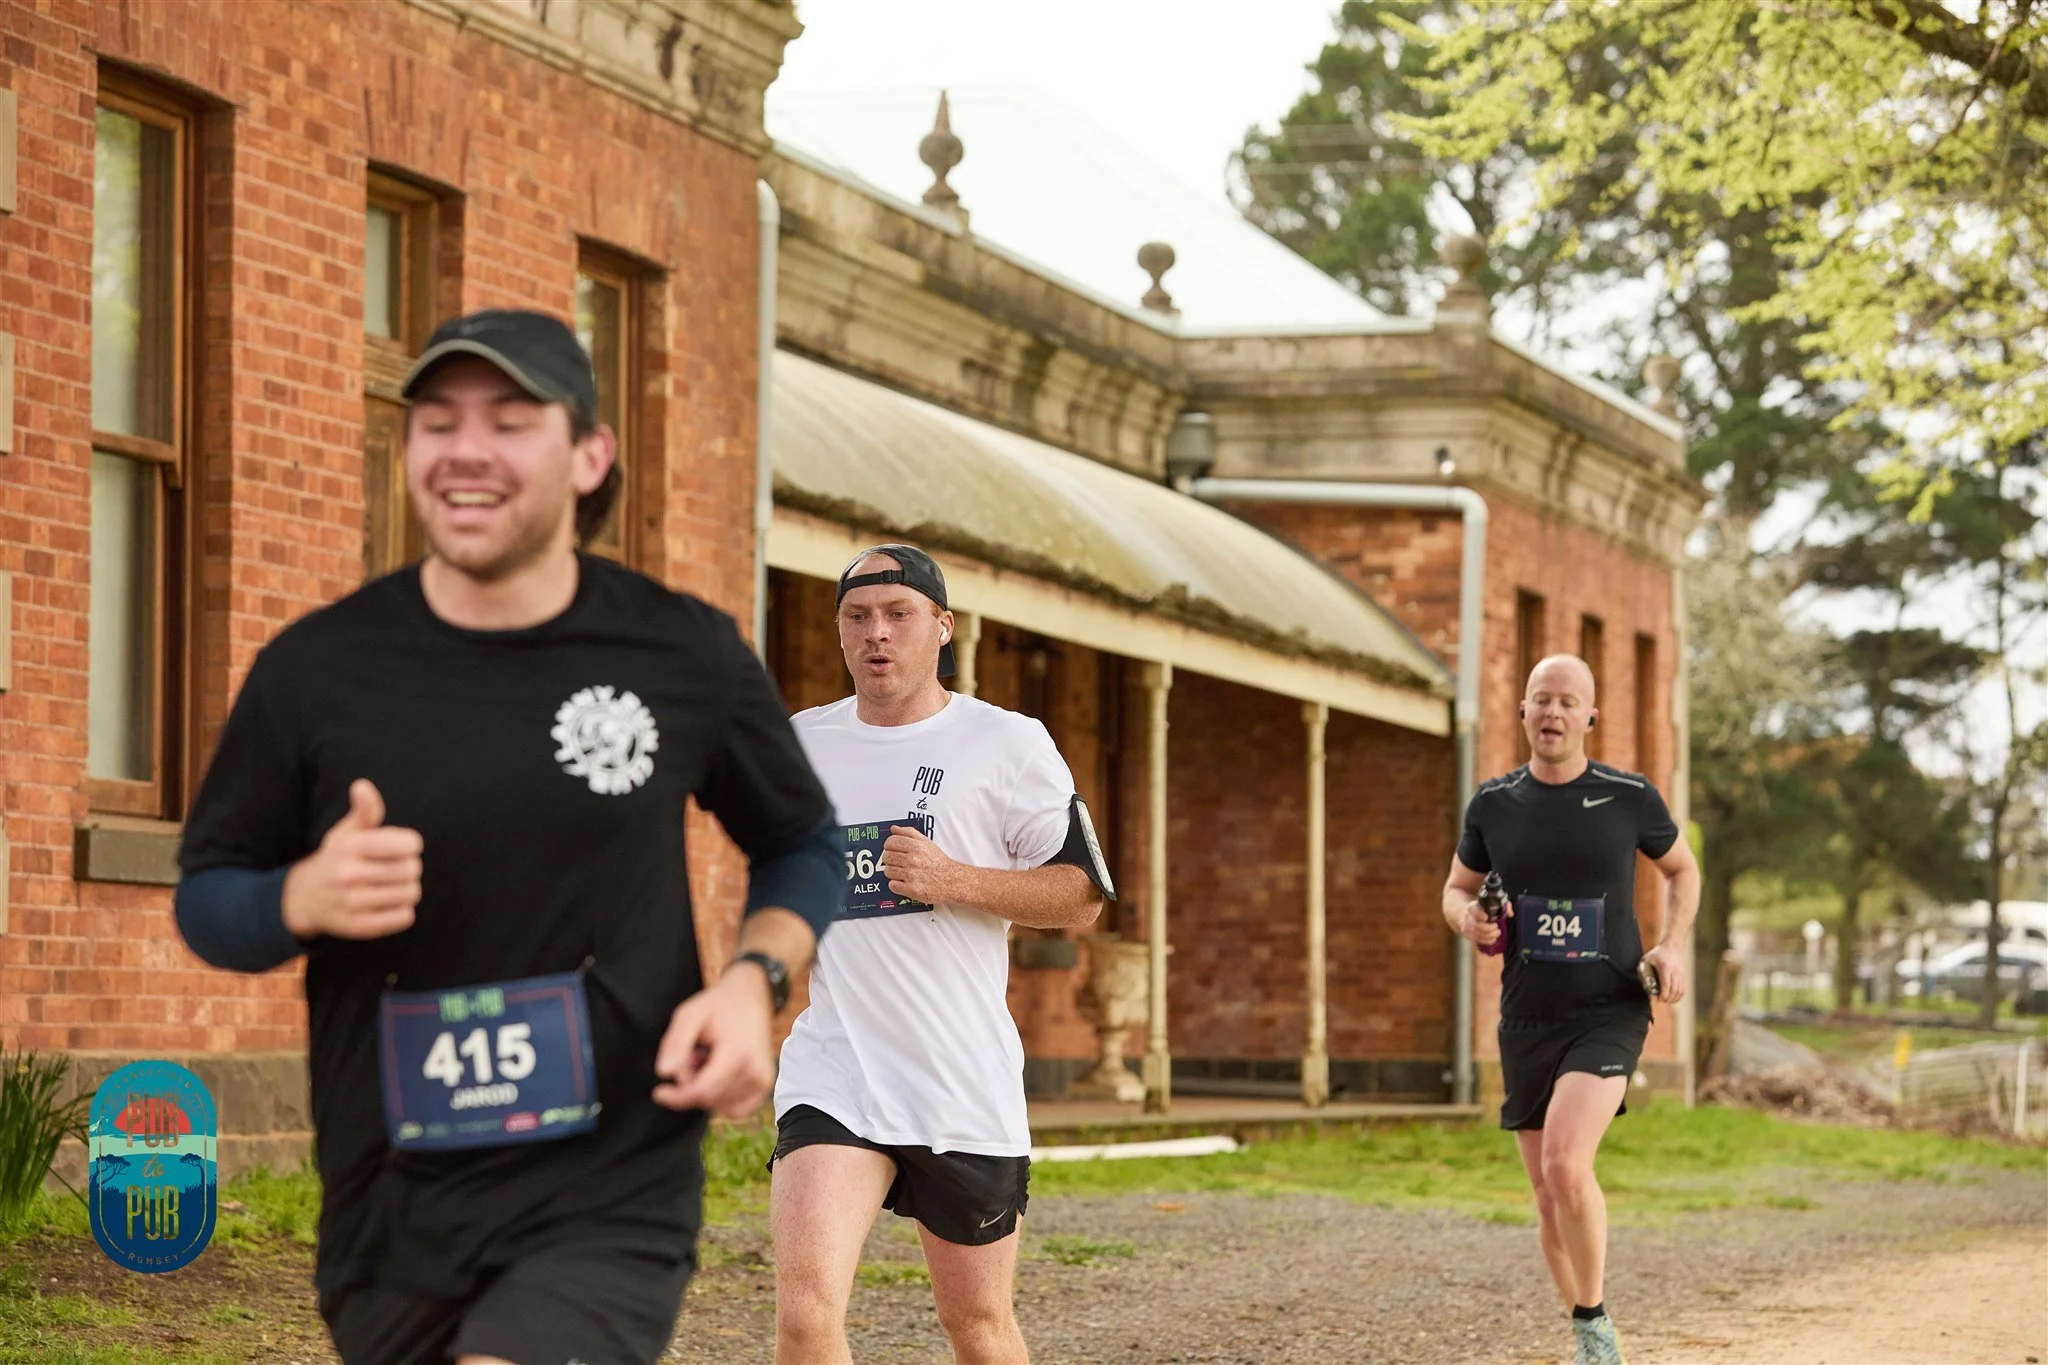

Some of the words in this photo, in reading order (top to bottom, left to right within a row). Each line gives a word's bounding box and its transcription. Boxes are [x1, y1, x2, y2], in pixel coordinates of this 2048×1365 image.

[912, 766, 944, 795] PUB
[916, 796, 928, 810] to
[847, 827, 861, 842] PUB
[866, 825, 879, 840] PUB
[854, 883, 881, 894] ALEX
[1537, 914, 1582, 937] 204
[422, 1022, 537, 1088] 415
